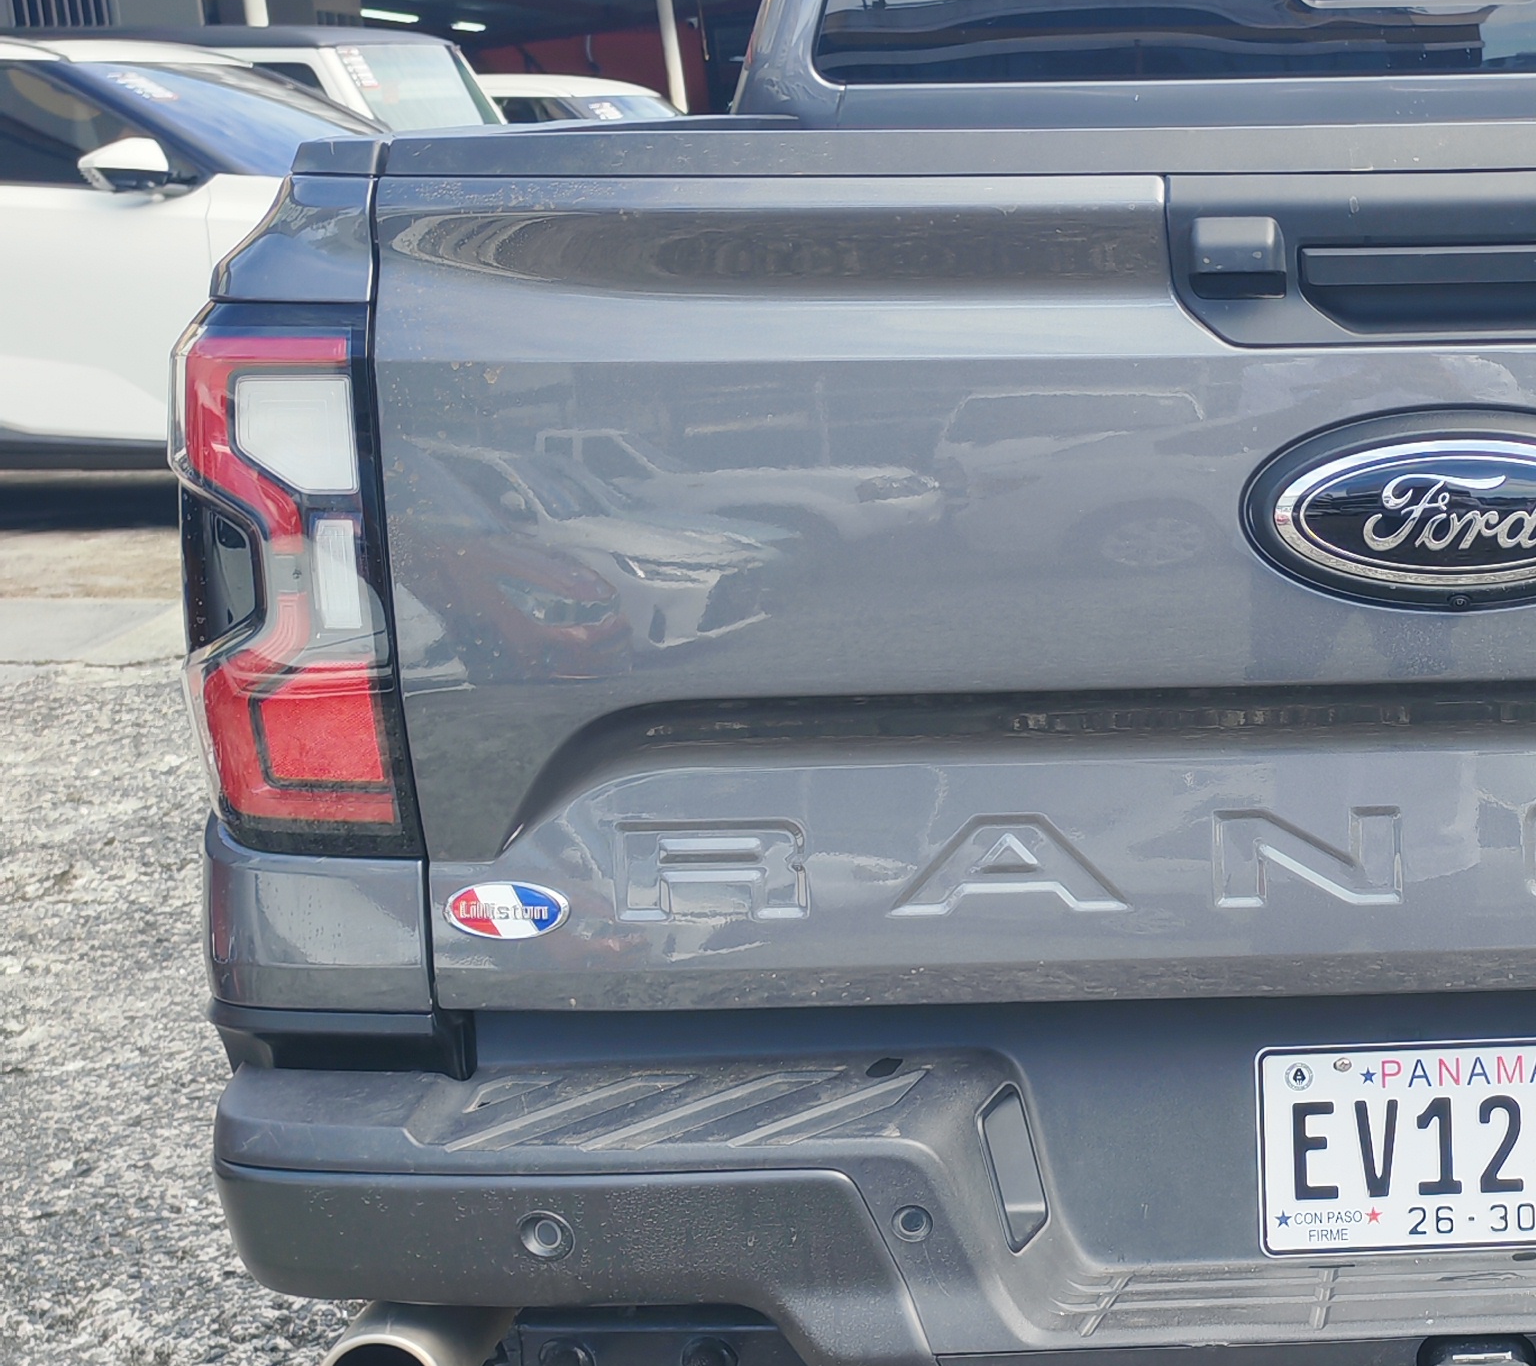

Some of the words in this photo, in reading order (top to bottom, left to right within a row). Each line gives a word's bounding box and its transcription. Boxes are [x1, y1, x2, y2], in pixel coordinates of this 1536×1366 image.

[1294, 1212, 1322, 1224] CON
[1327, 1210, 1363, 1223] PASO
[1308, 1228, 1349, 1242] FIRME
